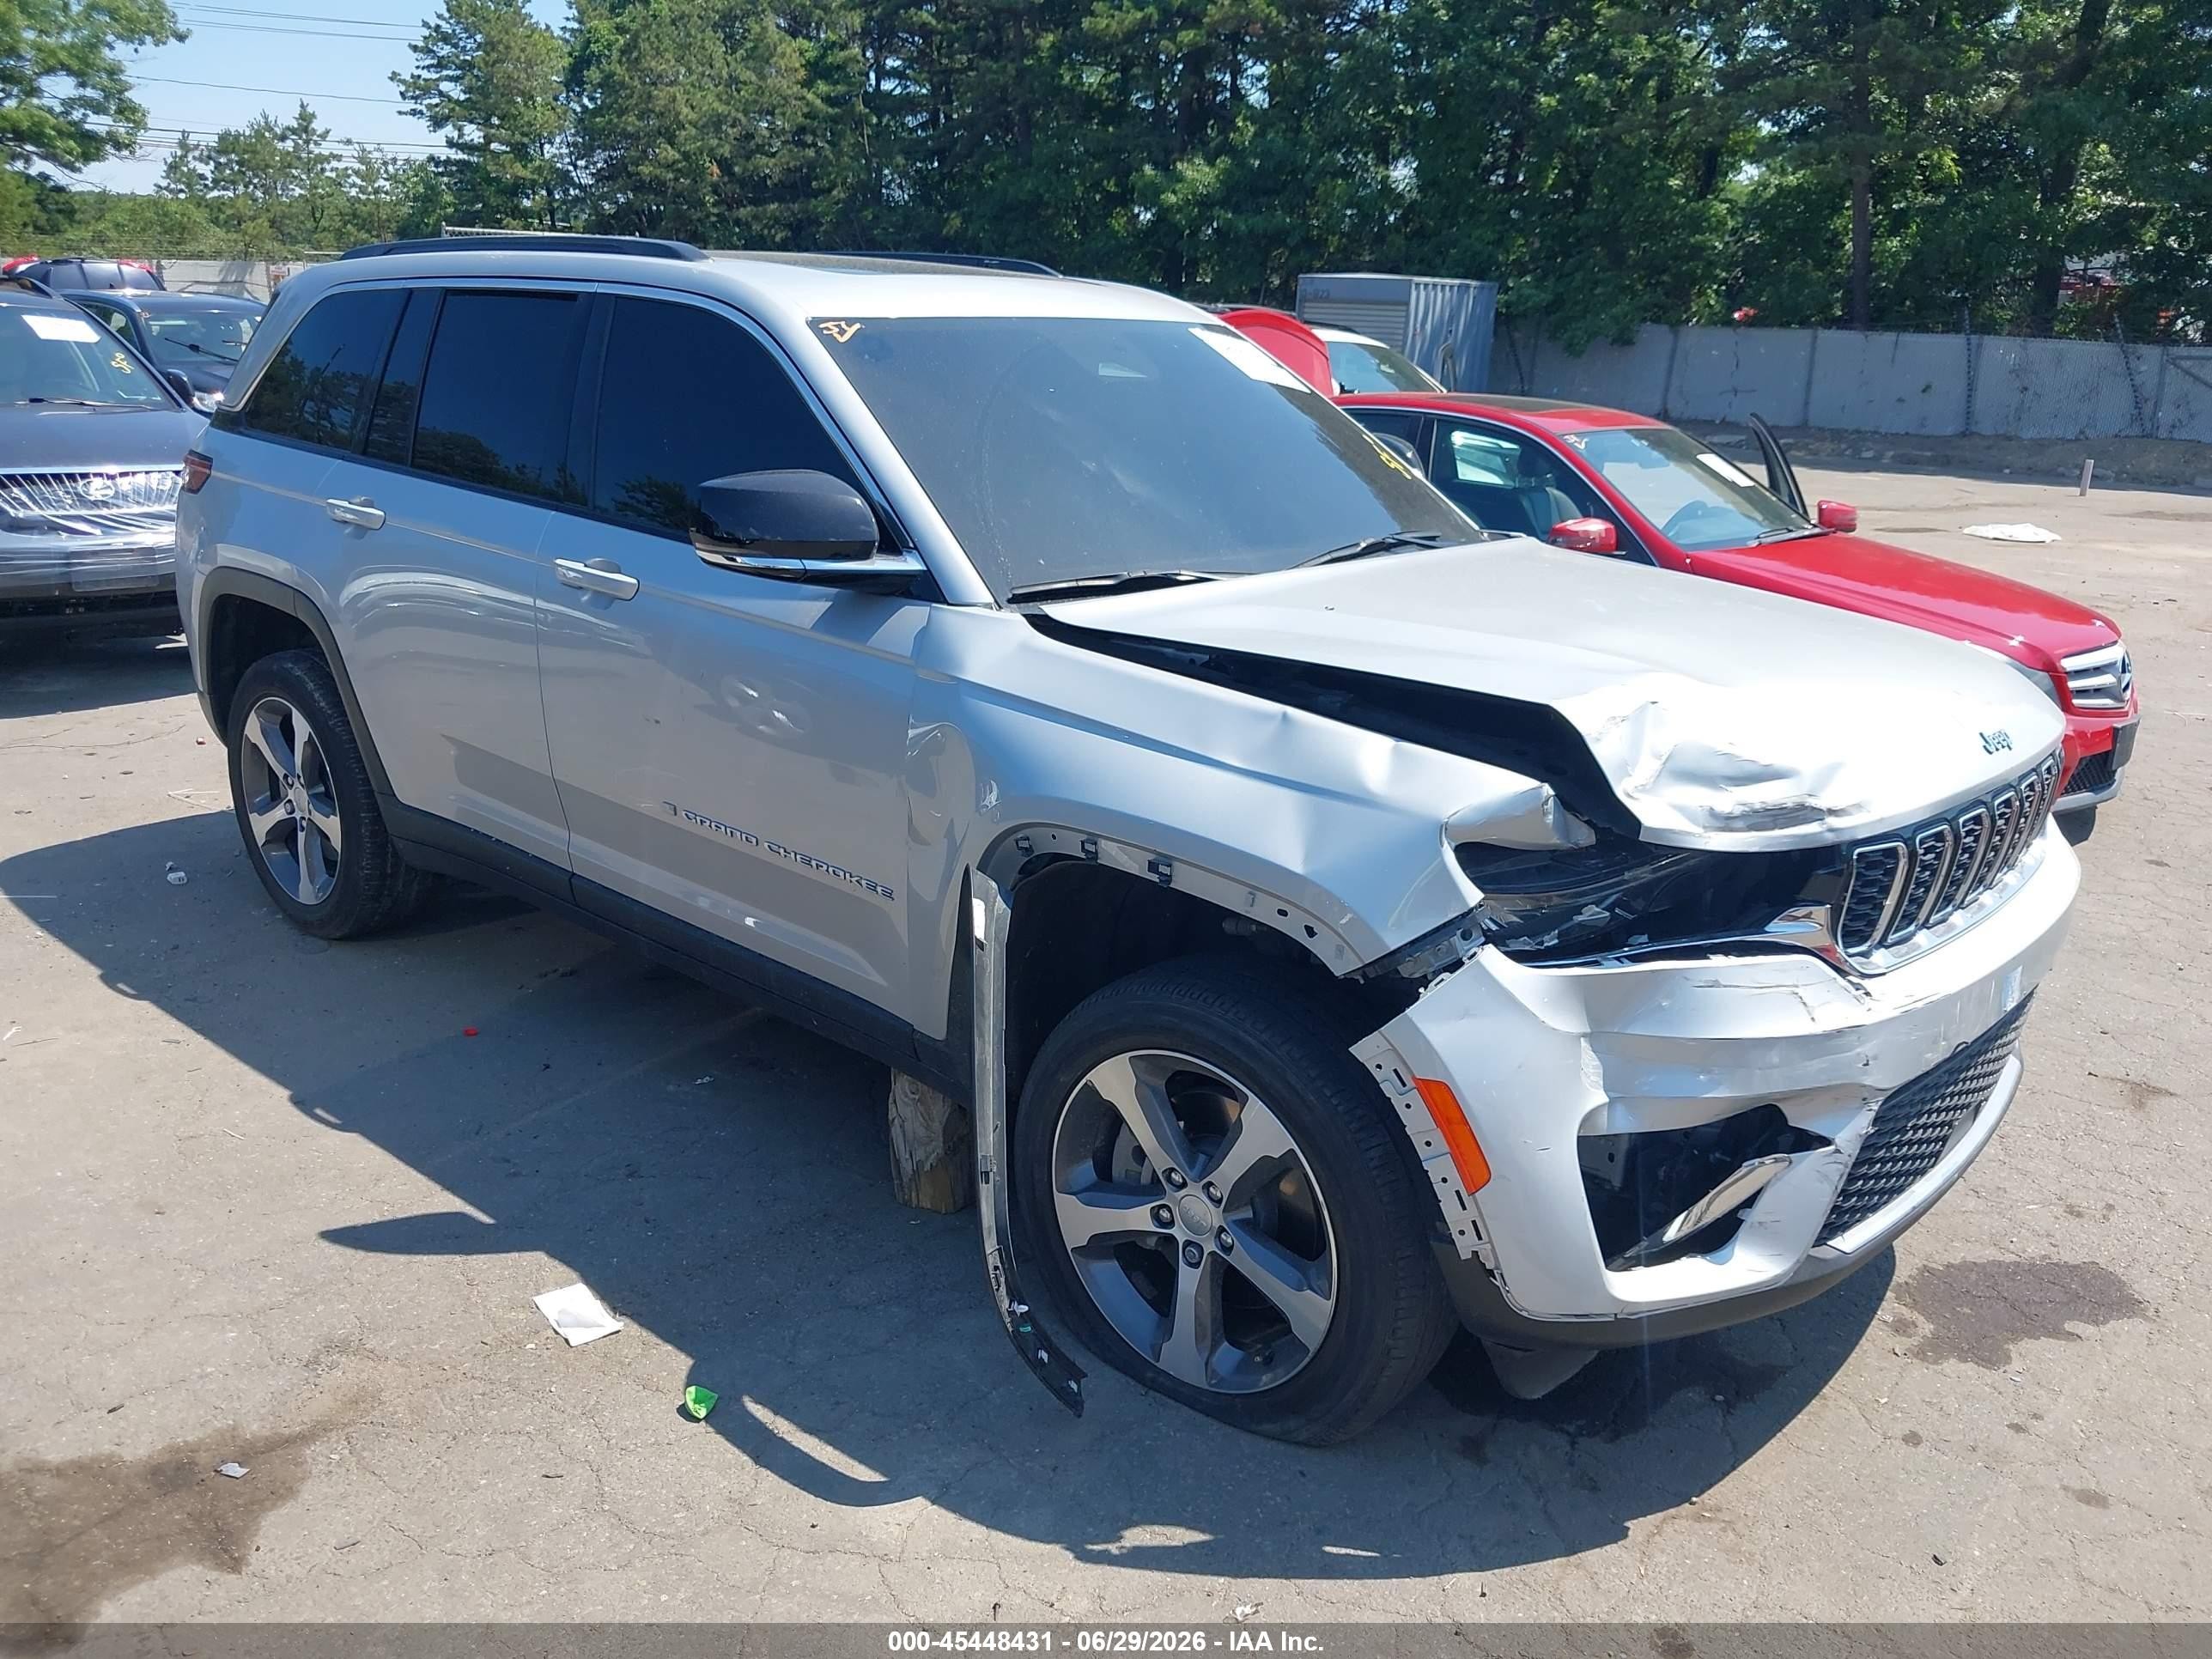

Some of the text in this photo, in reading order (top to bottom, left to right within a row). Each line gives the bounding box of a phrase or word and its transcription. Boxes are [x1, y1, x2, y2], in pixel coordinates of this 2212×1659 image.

[1978, 729, 2012, 755] Jeep
[682, 810, 895, 902] GRAND CHEROKEE
